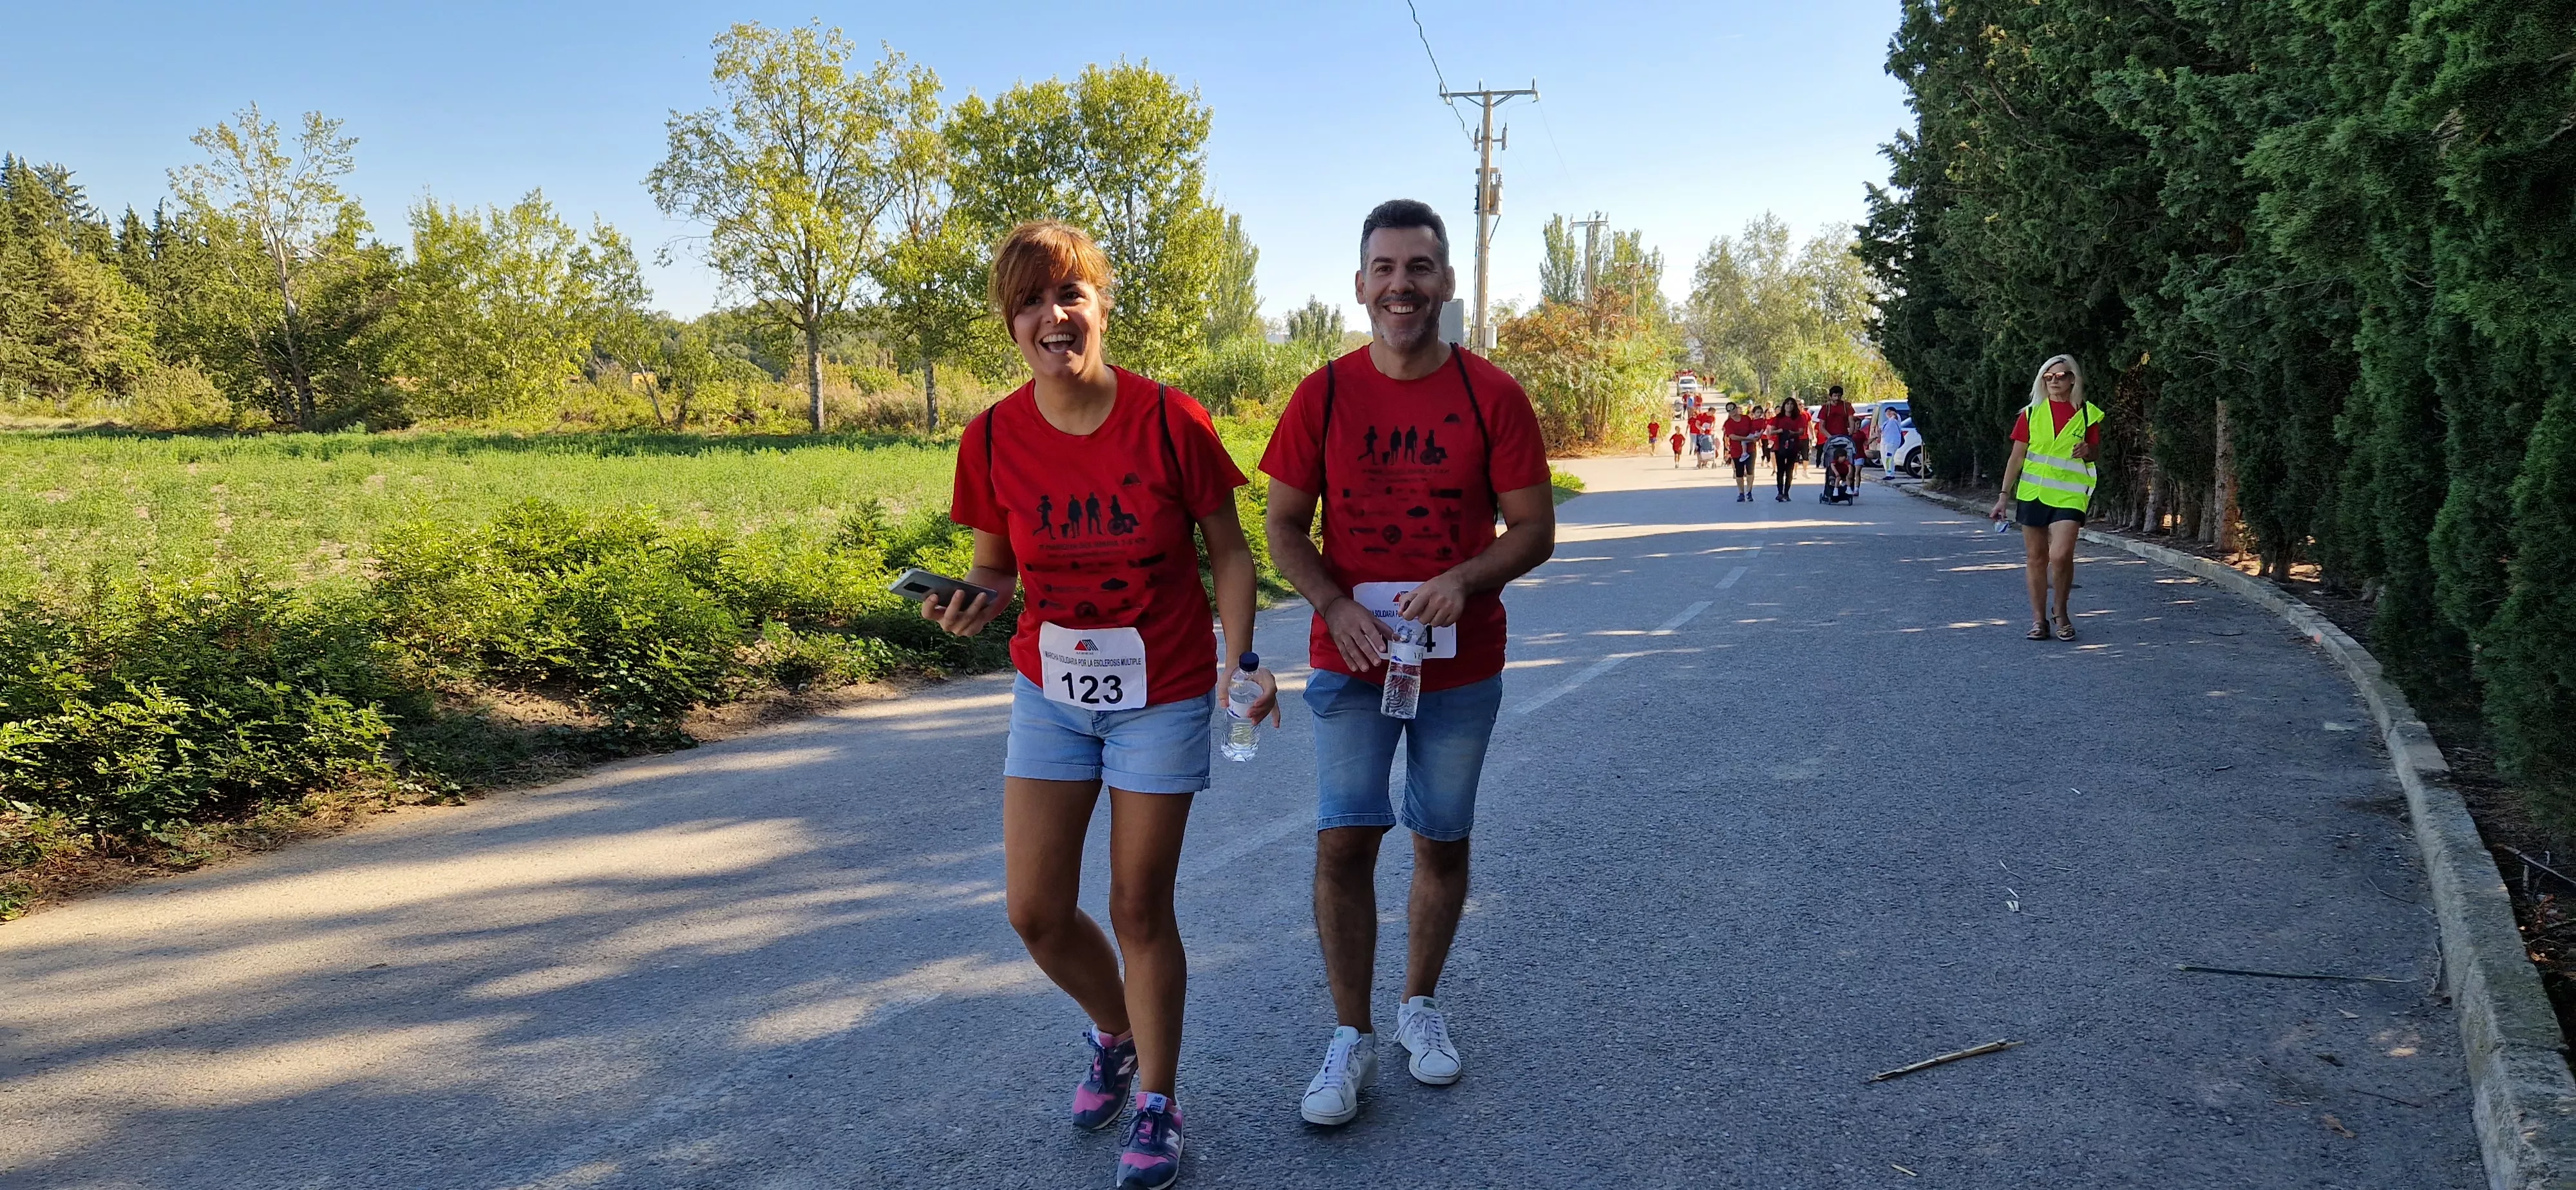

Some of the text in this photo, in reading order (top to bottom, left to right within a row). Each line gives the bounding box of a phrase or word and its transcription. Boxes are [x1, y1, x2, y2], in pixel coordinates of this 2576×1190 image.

[1045, 650, 1059, 661] MARCHA
[1058, 654, 1078, 666] SOLIDARIA
[1078, 659, 1087, 667] POR
[1087, 659, 1094, 667] LA
[1094, 658, 1121, 667] ESCLEROSIS
[1061, 672, 1123, 704] 123
